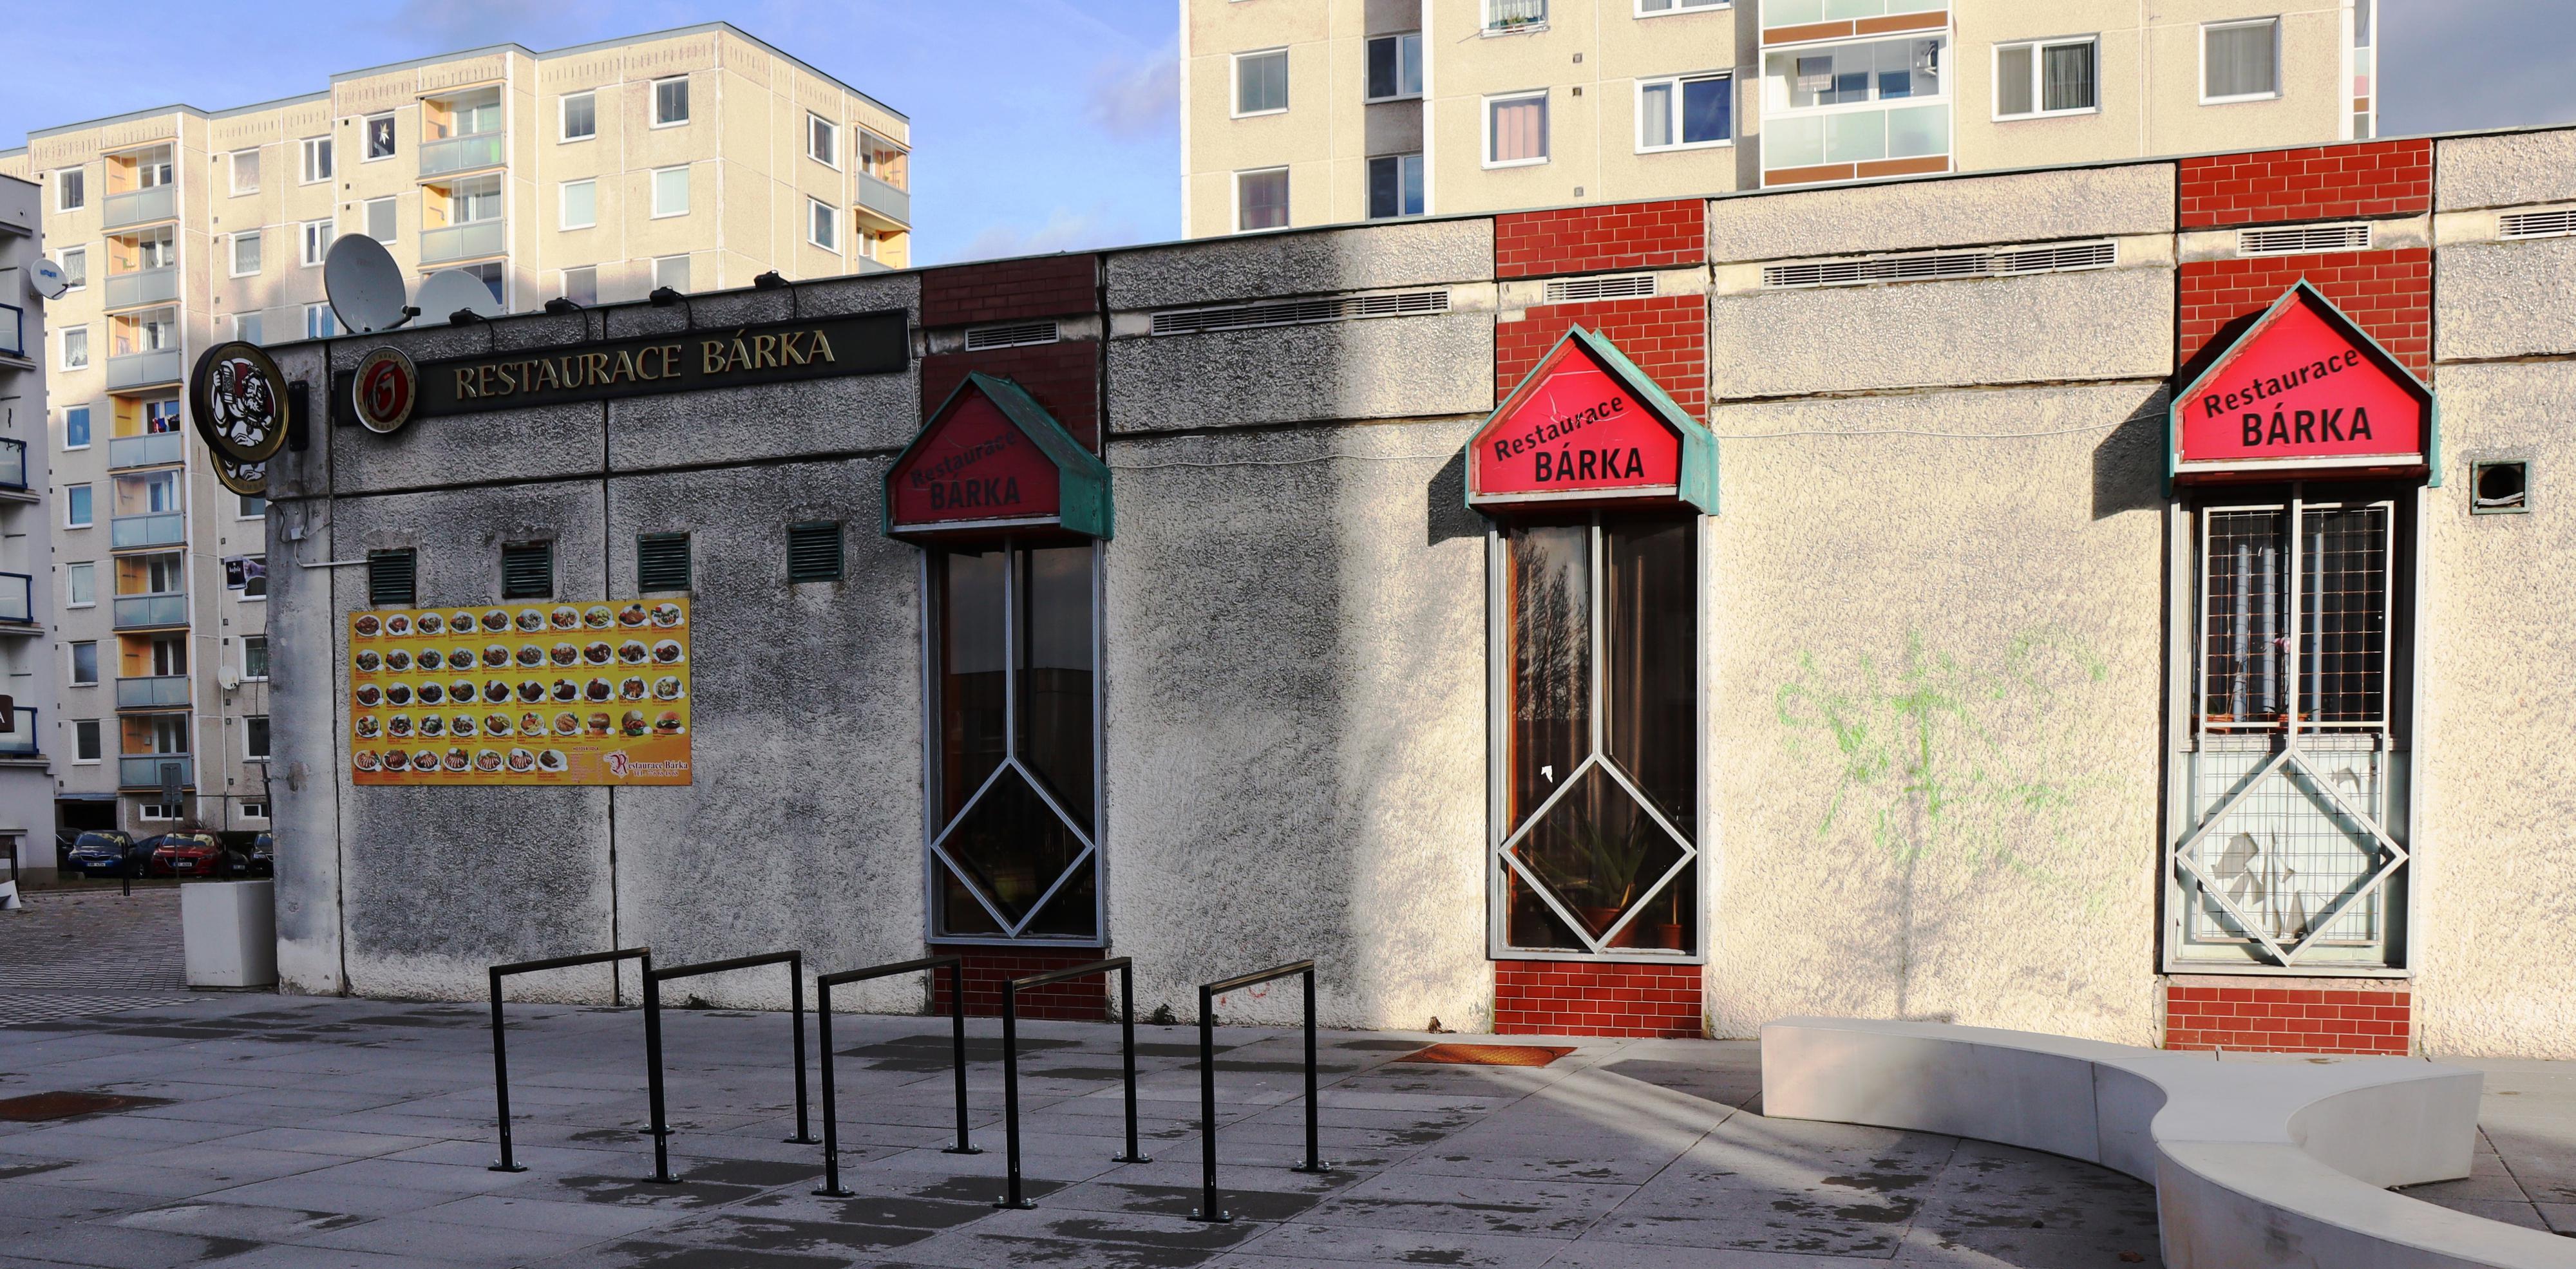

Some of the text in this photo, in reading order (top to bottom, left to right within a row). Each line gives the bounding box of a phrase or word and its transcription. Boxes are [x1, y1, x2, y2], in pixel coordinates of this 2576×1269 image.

[454, 329, 835, 399] RESTAURACE BÁRKA
[2203, 349, 2360, 418] Restaurace
[1494, 397, 1624, 462] Restaurace
[2242, 402, 2372, 447] BÁRKA
[910, 431, 1017, 487] Restaurace
[1535, 442, 1644, 482] BÁRKA
[931, 473, 1021, 510] BÁRKA
[665, 760, 688, 769] Bárka
